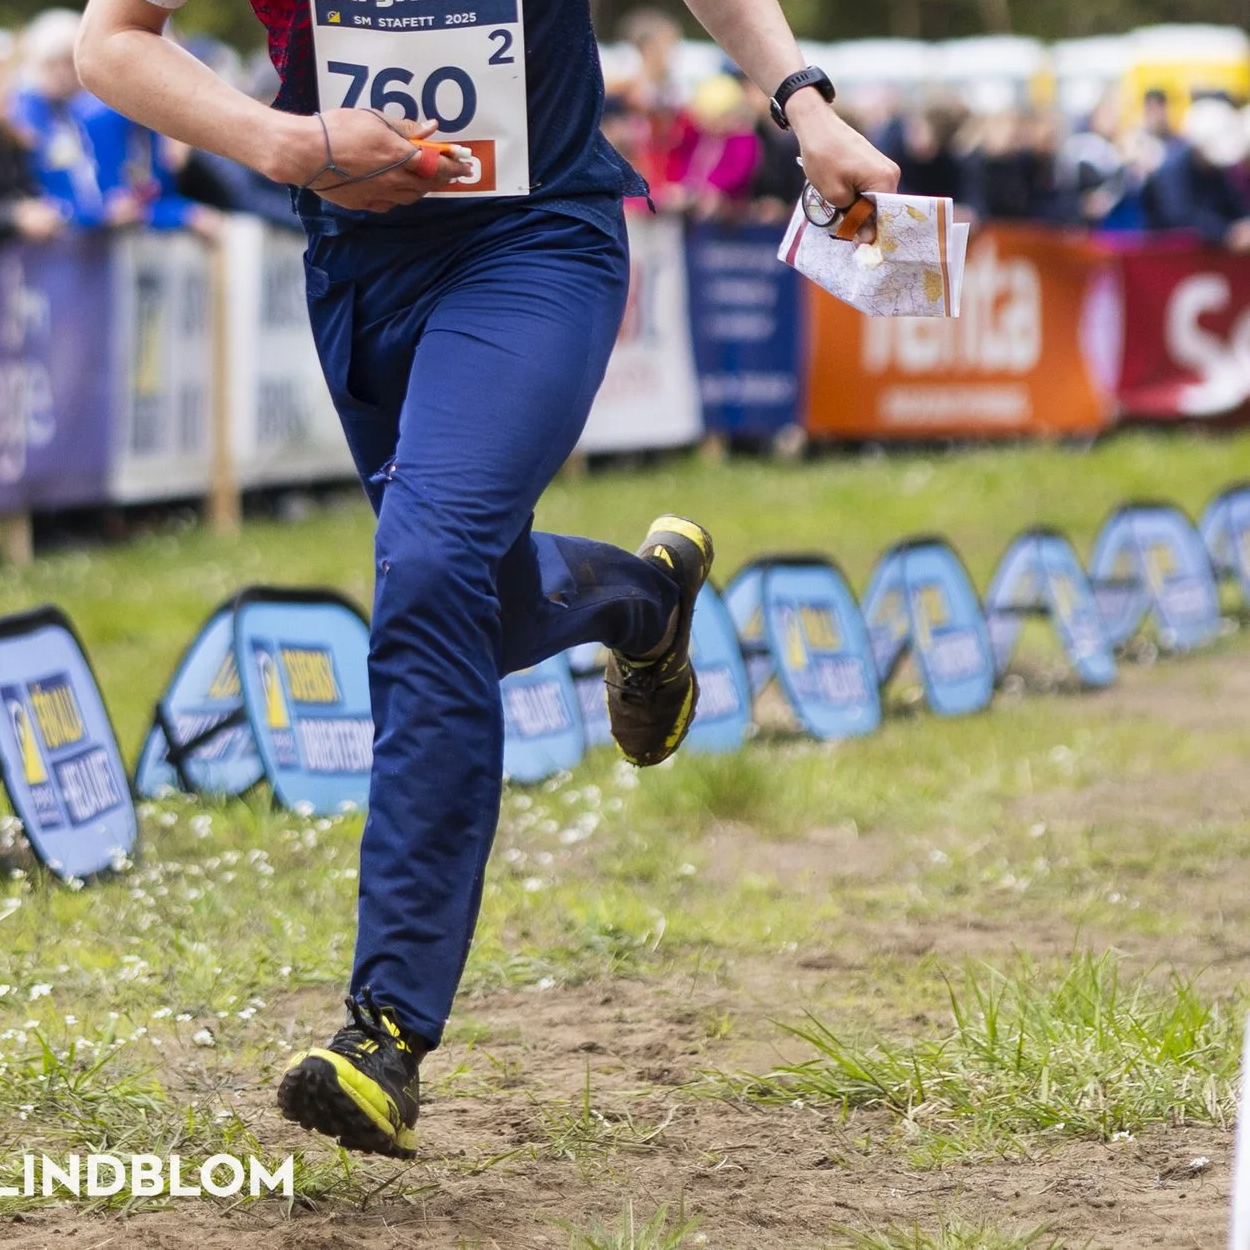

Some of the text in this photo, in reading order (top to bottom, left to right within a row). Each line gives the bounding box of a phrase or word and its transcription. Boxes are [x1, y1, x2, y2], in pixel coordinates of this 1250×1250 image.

[353, 12, 477, 28] SM STAFETT 2025
[487, 28, 515, 66] 2
[327, 60, 477, 134] 760
